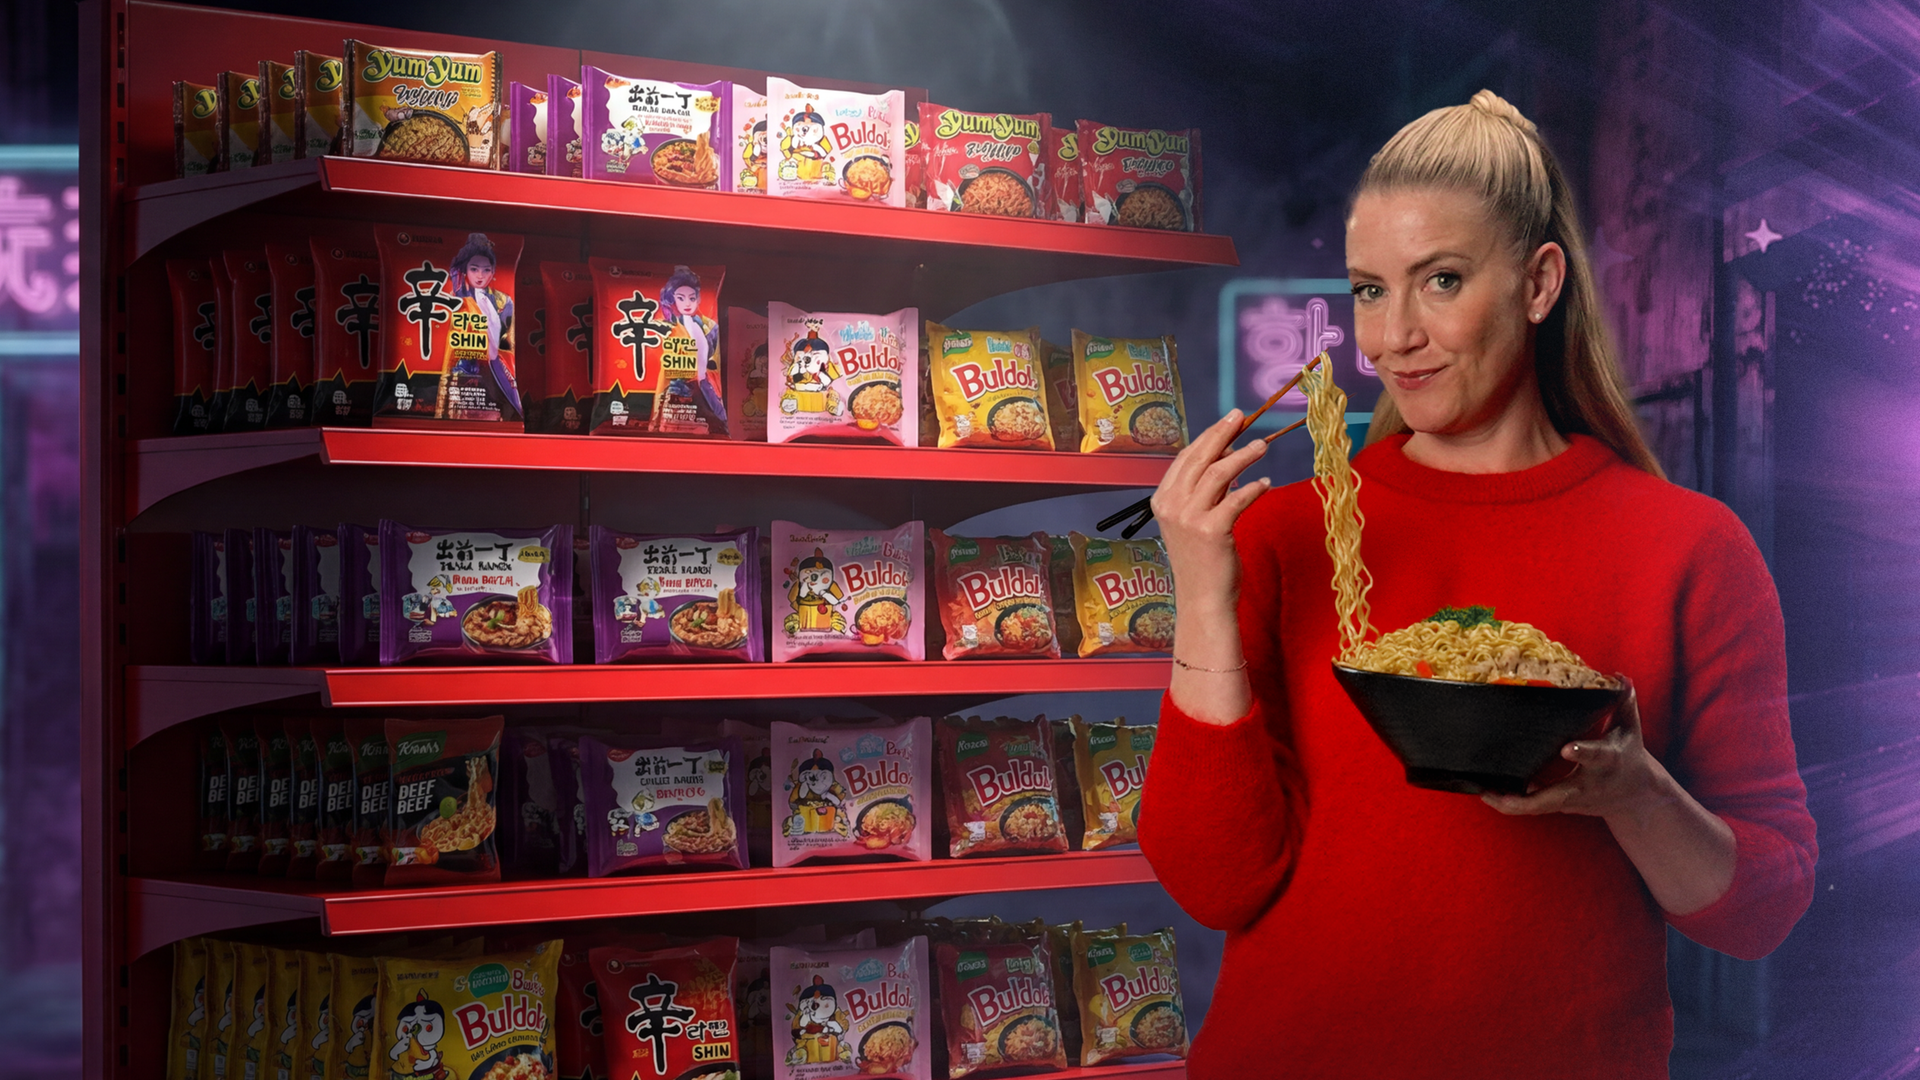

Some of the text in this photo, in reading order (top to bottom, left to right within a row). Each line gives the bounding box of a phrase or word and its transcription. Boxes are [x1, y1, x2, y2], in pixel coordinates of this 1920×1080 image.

[399, 260, 463, 360] 辛
[451, 332, 486, 349] SHIN
[611, 290, 672, 381] 辛
[663, 354, 697, 369] SHIN
[1100, 755, 1146, 800] Bul
[396, 794, 434, 815] BEEF
[453, 994, 546, 1050] Buldok
[626, 973, 695, 1075] 辛
[693, 1044, 729, 1060] SHIN
